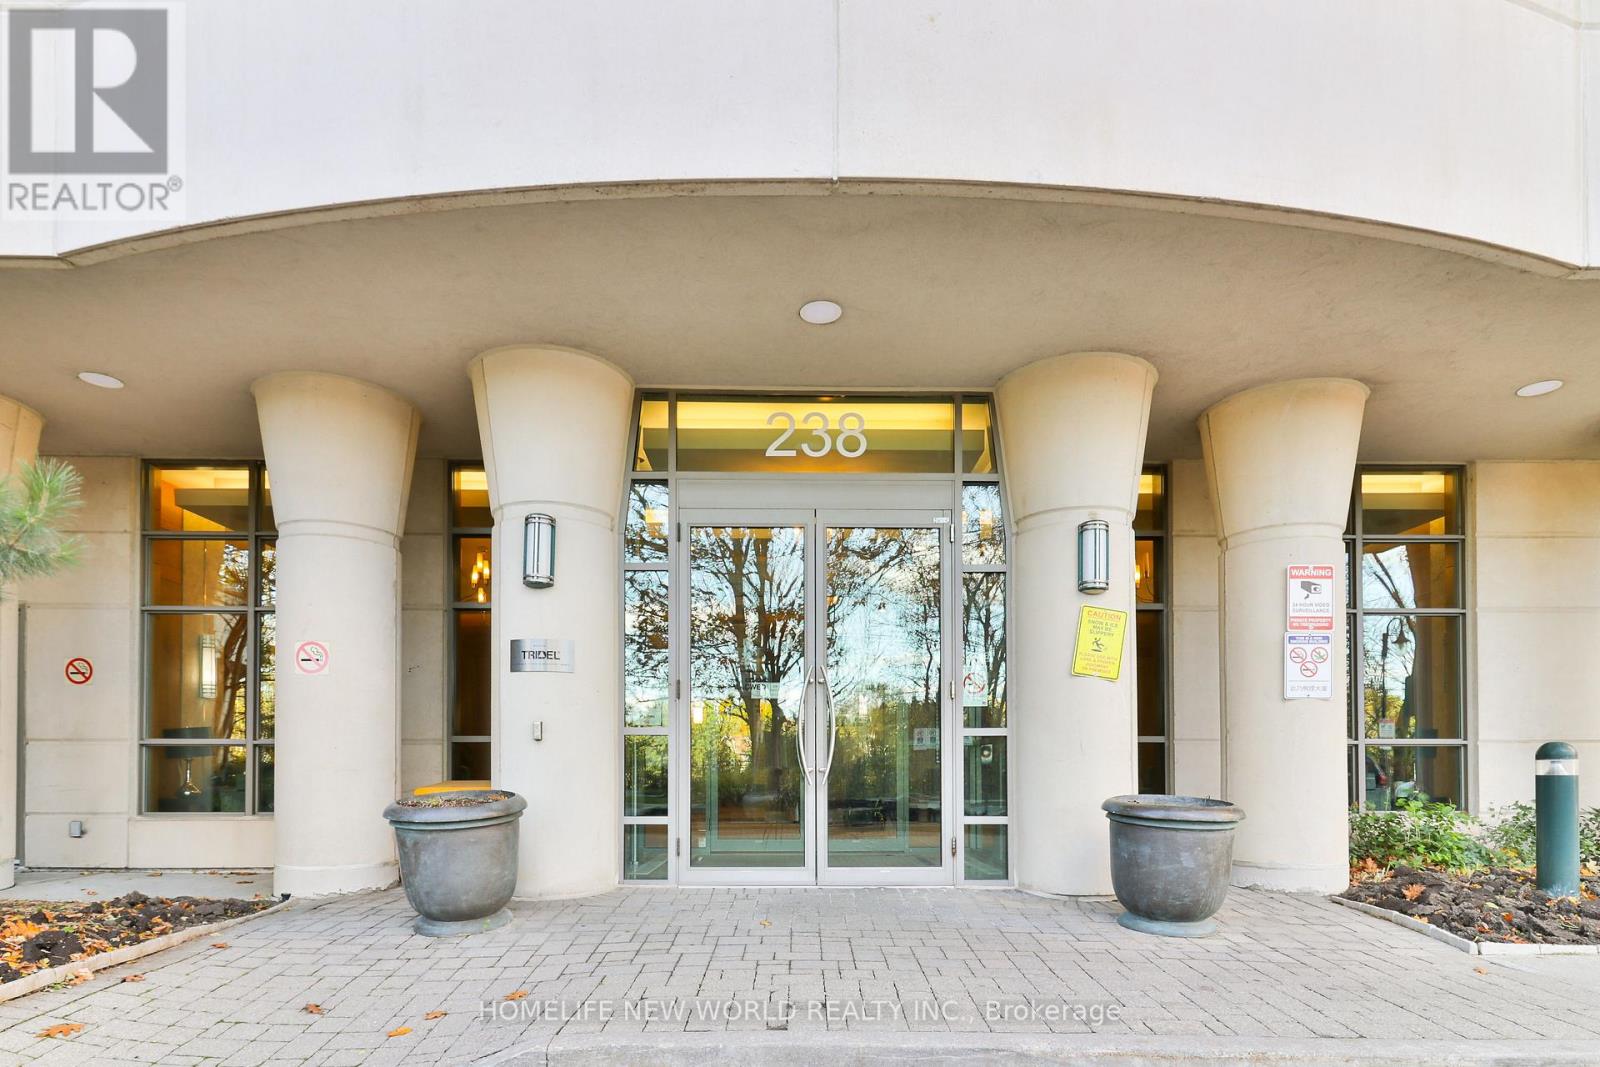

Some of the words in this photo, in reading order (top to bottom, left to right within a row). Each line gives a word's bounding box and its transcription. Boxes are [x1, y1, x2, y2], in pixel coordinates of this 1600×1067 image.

[765, 411, 867, 458] 238
[1291, 568, 1332, 577] WARNING
[1087, 610, 1121, 621] CAUTION
[521, 650, 561, 660] TRIDEL
